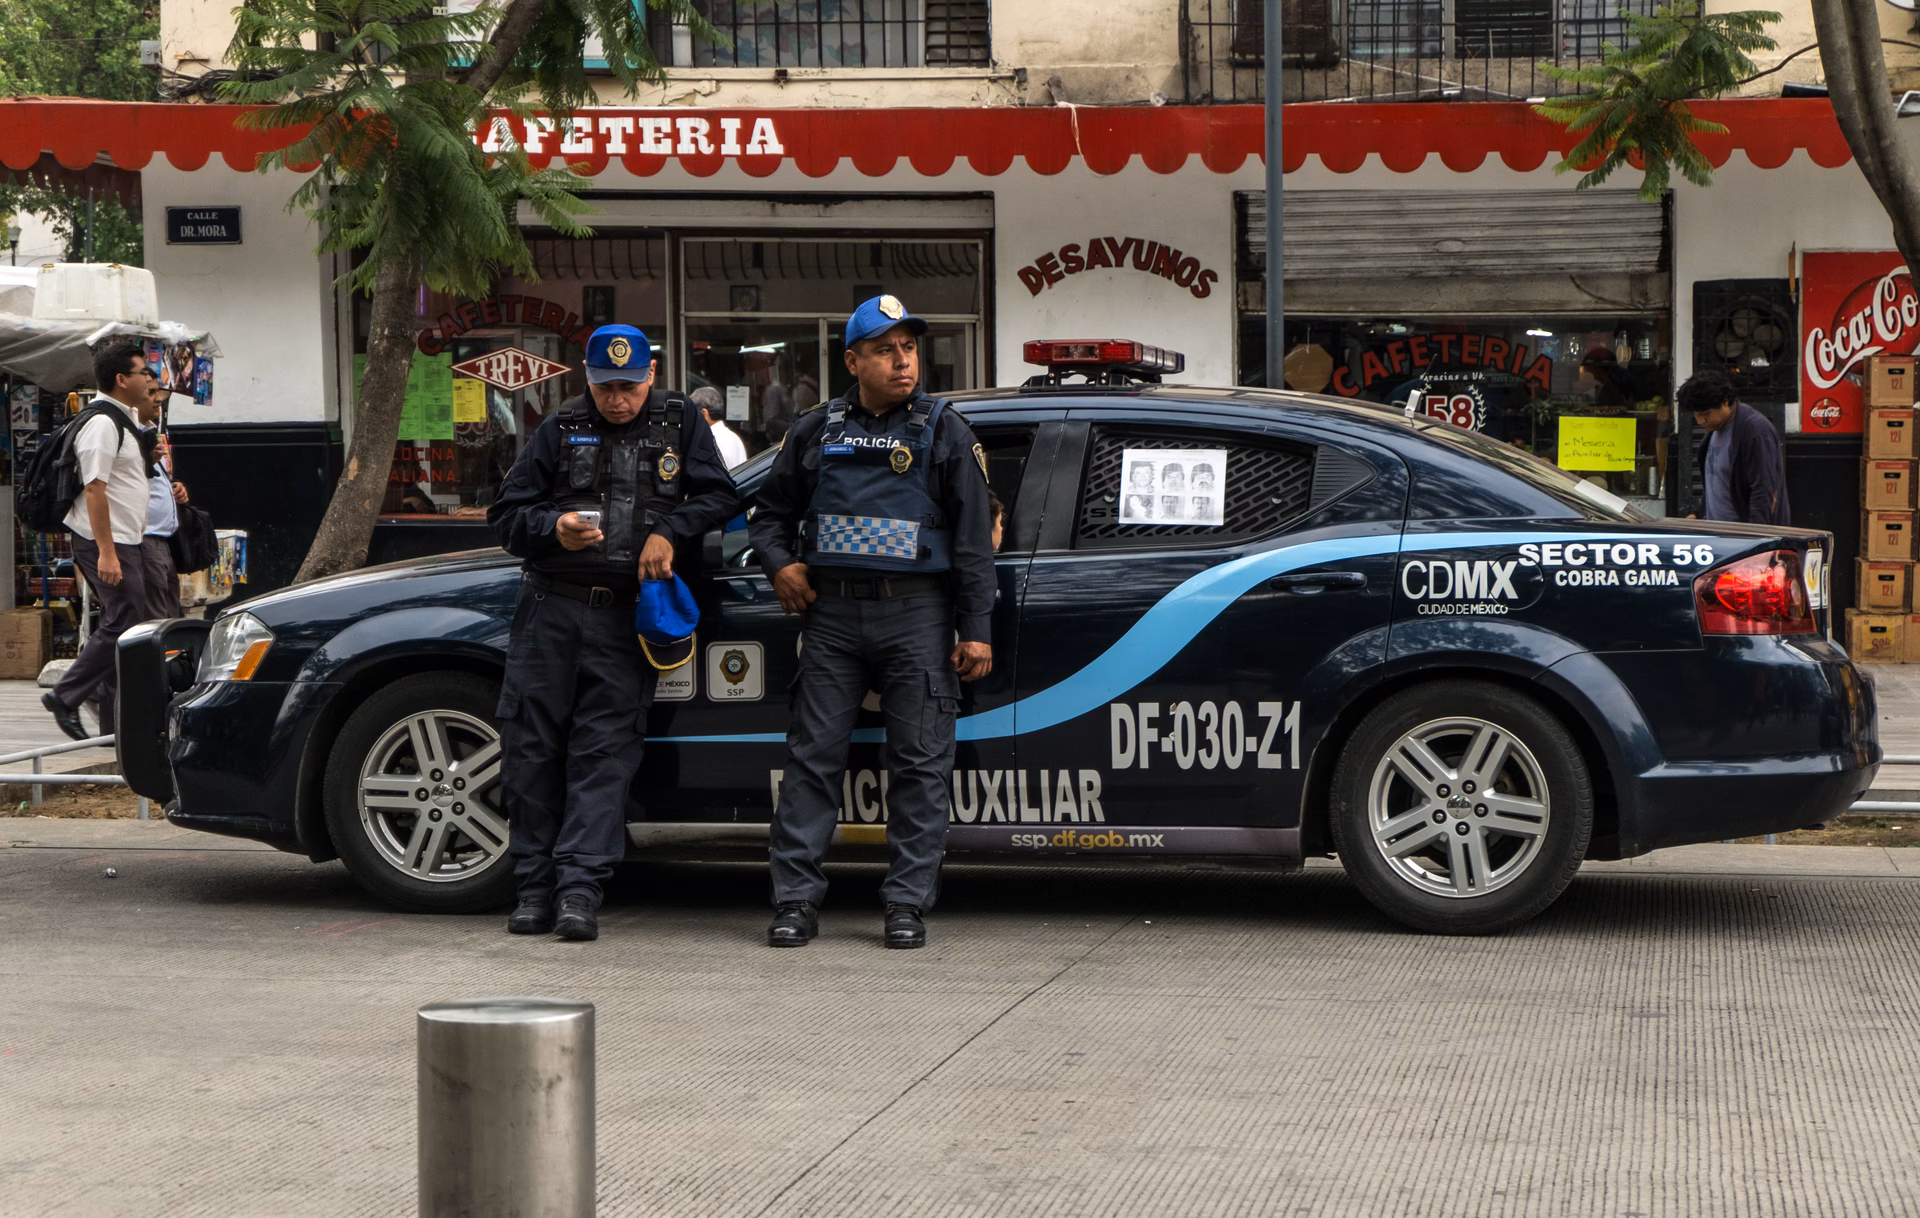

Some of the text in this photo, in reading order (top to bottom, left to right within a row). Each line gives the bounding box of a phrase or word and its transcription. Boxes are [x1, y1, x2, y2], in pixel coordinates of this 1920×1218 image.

[464, 116, 784, 155] AFETERIA
[187, 211, 219, 220] CALLE
[1017, 236, 1219, 299] DESAYUNOS
[1805, 265, 1919, 389] Coca-Co
[475, 350, 550, 388] TREVI
[1332, 333, 1553, 398] CAFETERIA
[1426, 395, 1476, 430] 58
[843, 436, 901, 449] POLICÍA
[389, 469, 456, 483] ALIANA
[1518, 543, 1714, 567] SECTOR 56
[1401, 560, 1519, 600] CDMX
[1555, 569, 1680, 587] COBRA GAMA
[1417, 601, 1509, 615] CIUDAD DE MÉXICO
[665, 680, 690, 688] MÉXICO
[726, 688, 745, 697] SSP
[1110, 700, 1301, 771] DF-030-Z1
[949, 769, 1106, 823] UXILIAR
[1011, 830, 1165, 850] ssp.df.gob.mx
